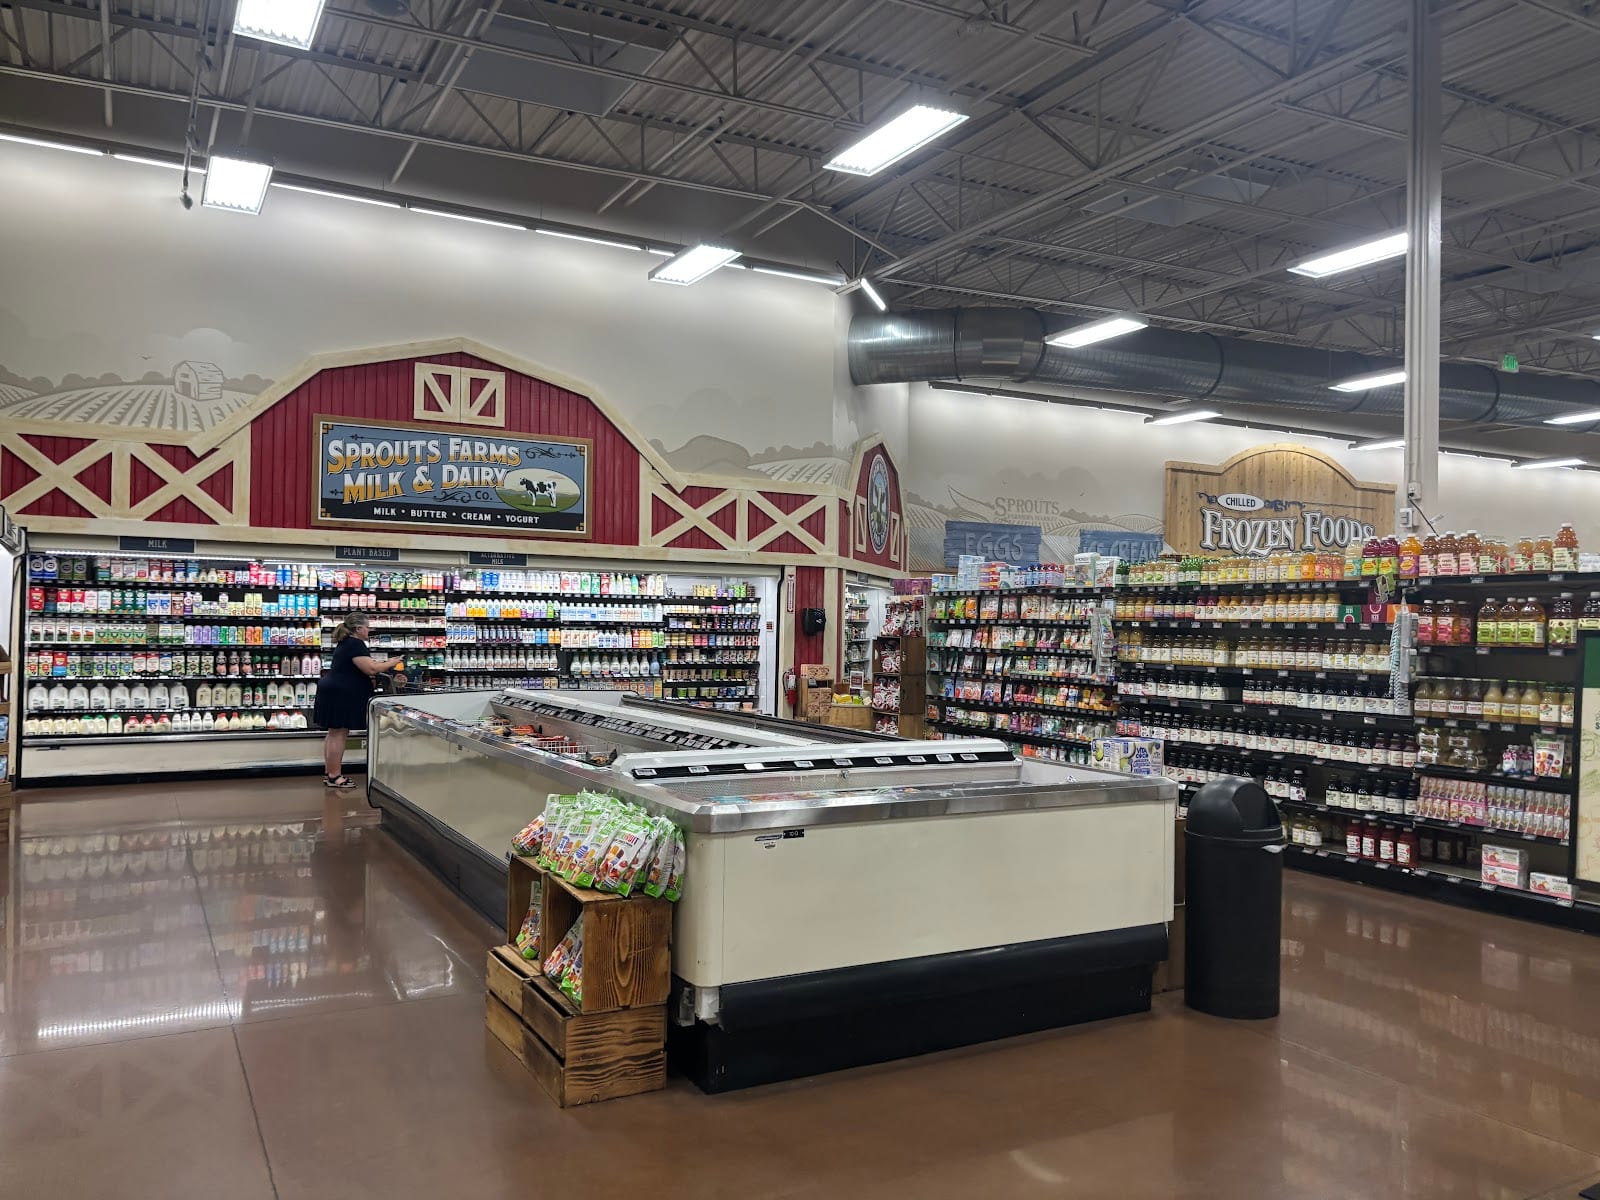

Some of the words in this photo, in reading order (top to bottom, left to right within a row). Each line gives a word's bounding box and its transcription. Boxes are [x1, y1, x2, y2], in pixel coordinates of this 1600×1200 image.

[327, 439, 441, 475] SPROUTS
[448, 437, 522, 467] FARMS
[342, 470, 406, 504] MILK
[412, 464, 435, 493] &
[441, 465, 511, 489] DAIRY
[995, 496, 1060, 517] SPROUTS
[1225, 497, 1256, 508] CHILLED
[373, 507, 397, 517] MILK
[410, 509, 447, 519] BUTTER
[461, 511, 491, 521] CREAM
[505, 514, 540, 524] YOGURT
[1200, 508, 1298, 558] FROZEN
[147, 539, 168, 549] MILK
[343, 548, 366, 557] PLANT
[369, 549, 391, 558] BASED
[965, 532, 1024, 561] EGGS
[1110, 540, 1161, 562] CREAM
[491, 558, 504, 566] MILK
